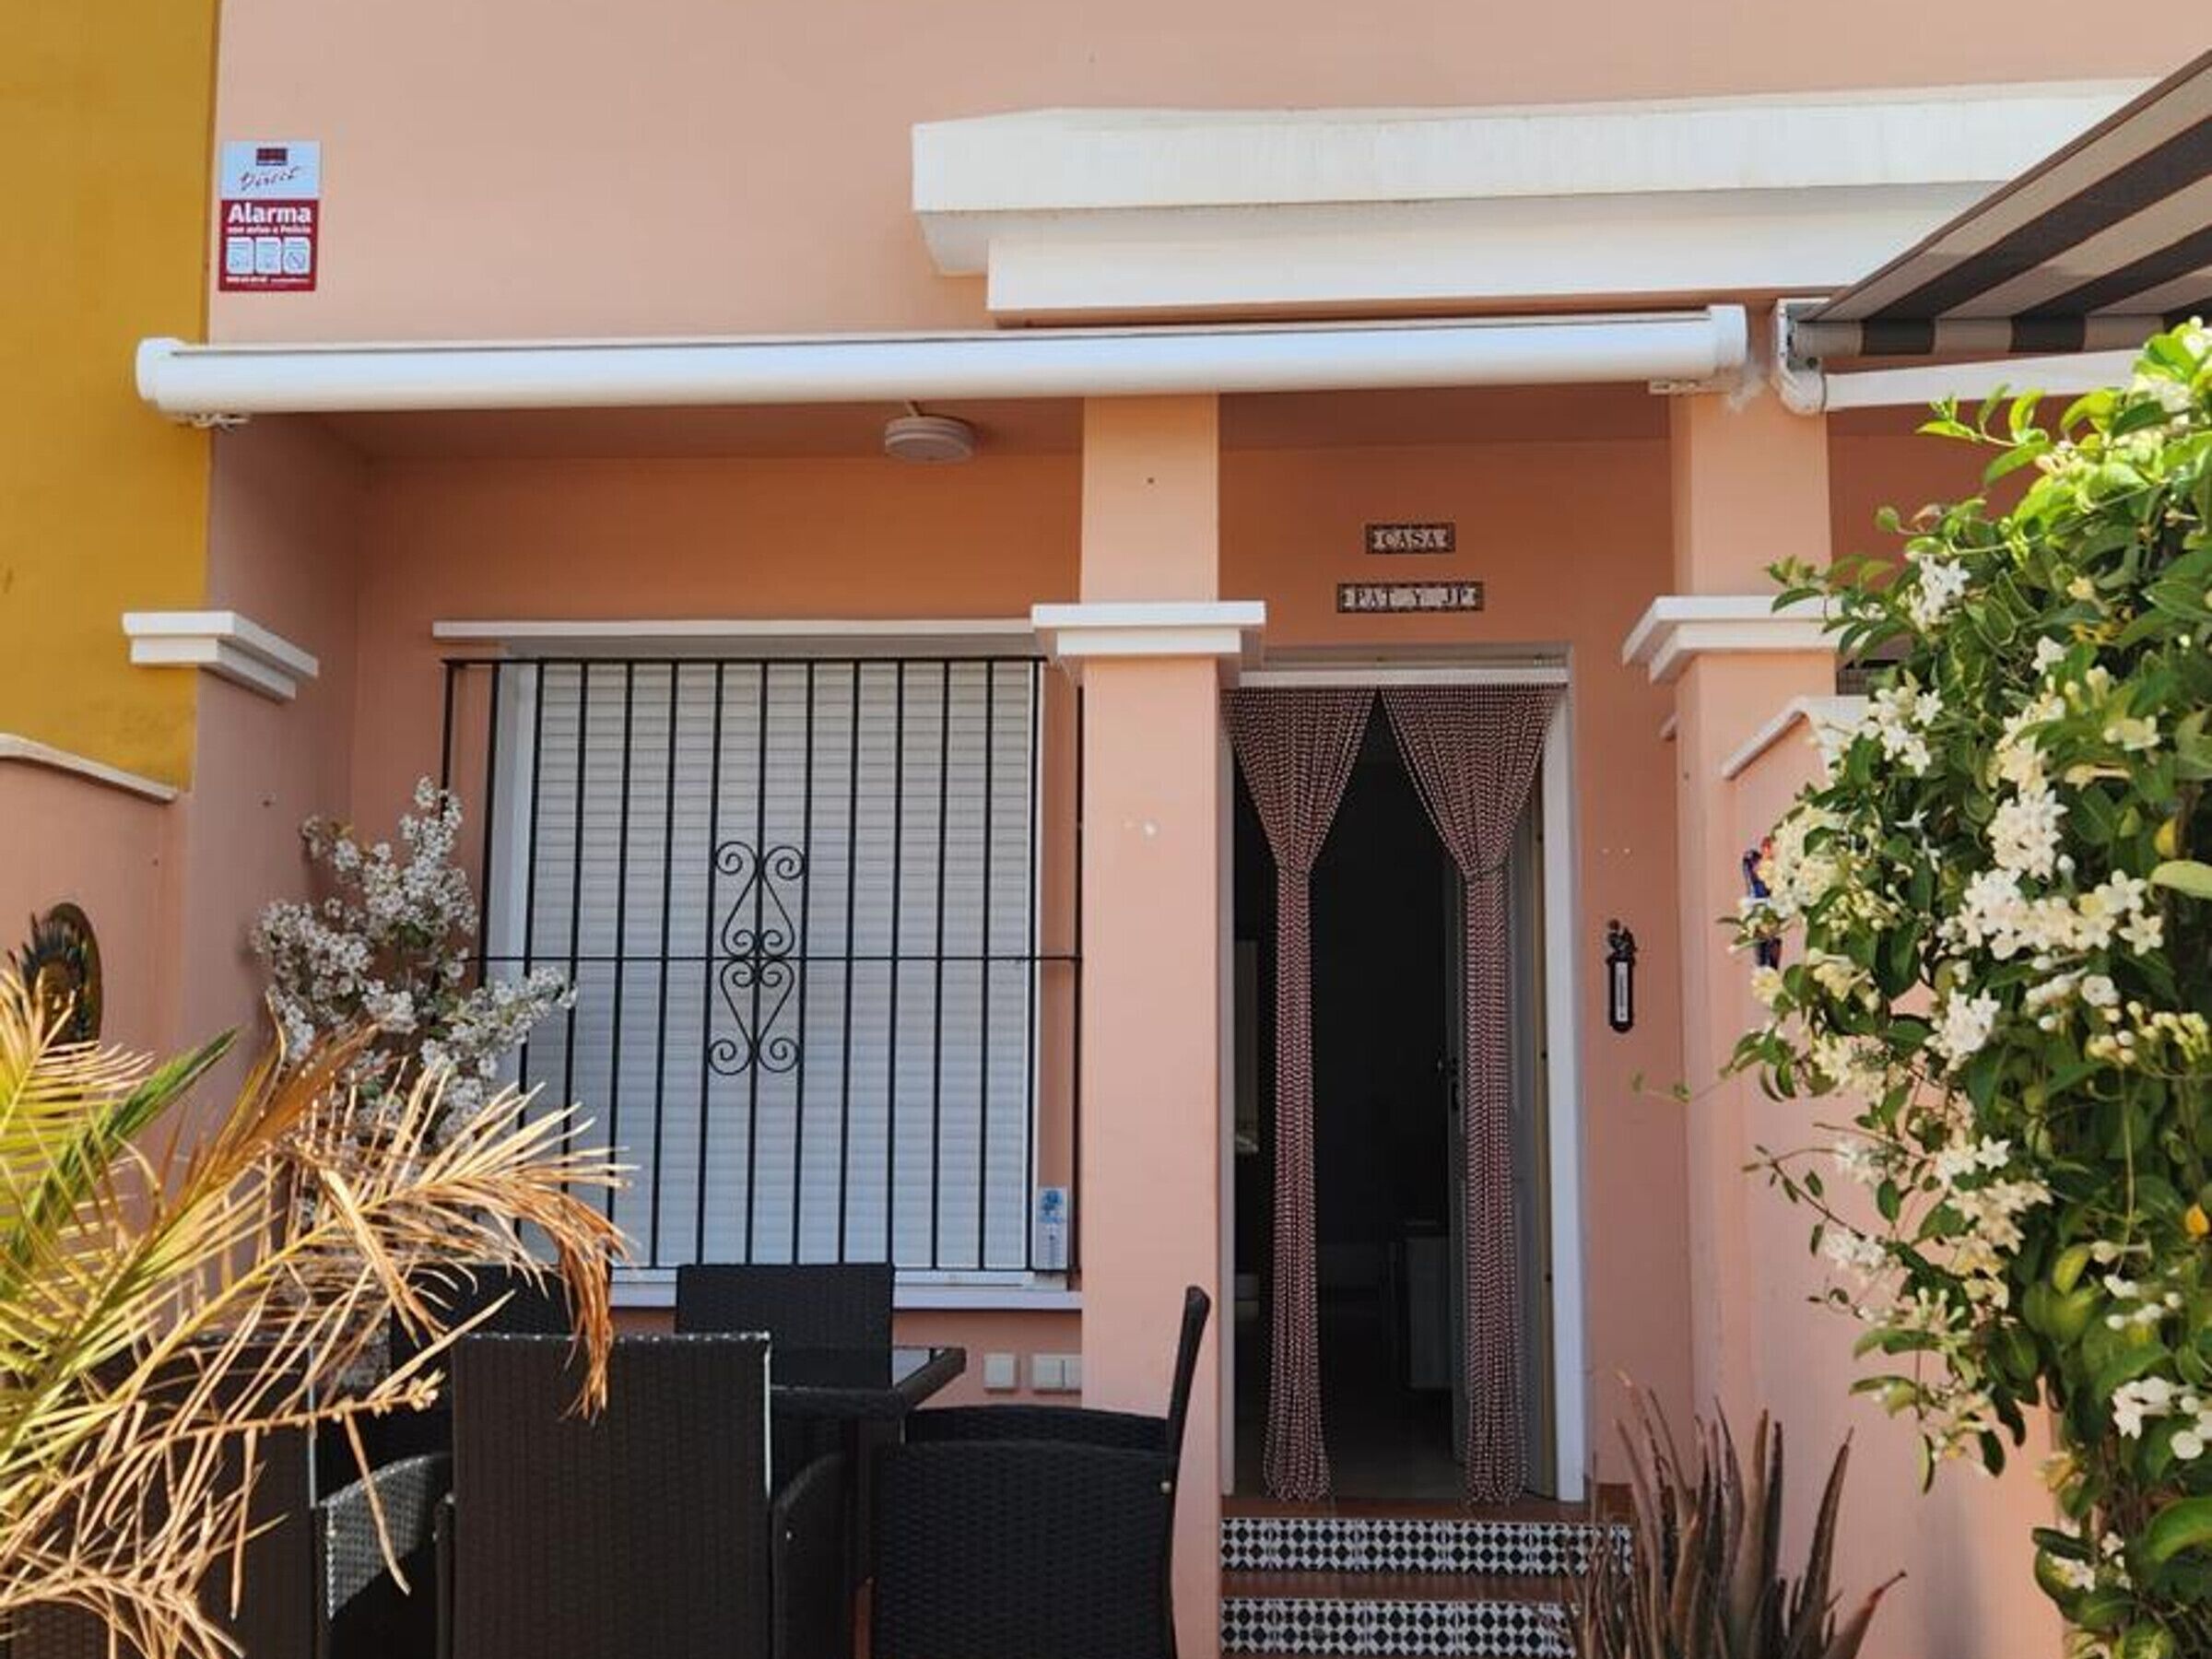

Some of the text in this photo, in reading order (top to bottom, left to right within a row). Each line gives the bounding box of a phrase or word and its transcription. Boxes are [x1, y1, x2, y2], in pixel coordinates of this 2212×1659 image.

[228, 202, 312, 223] Alarma
[1382, 529, 1438, 548] CASA
[1354, 588, 1394, 607] PAT
[1410, 588, 1425, 606] Y
